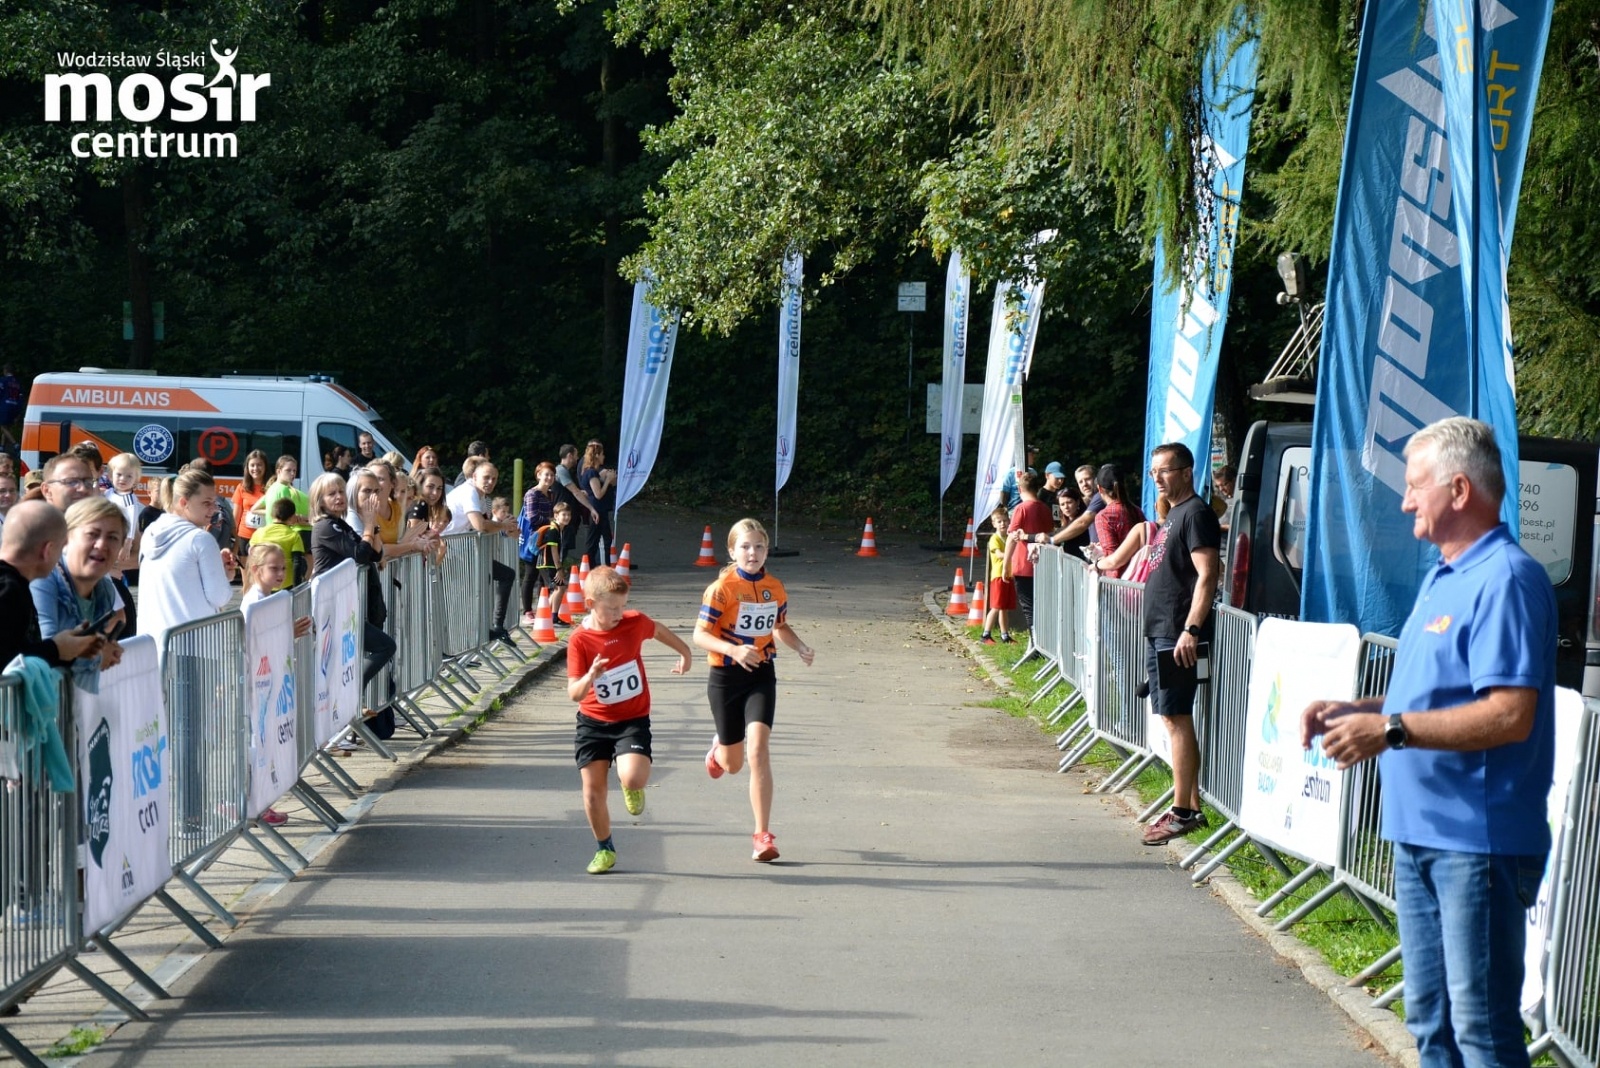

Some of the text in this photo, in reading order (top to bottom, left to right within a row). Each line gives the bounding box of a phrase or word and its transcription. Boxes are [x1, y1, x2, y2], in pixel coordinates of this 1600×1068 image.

[1487, 50, 1520, 151] ORT
[61, 388, 170, 406] AMBULANS
[209, 435, 228, 457] P
[218, 485, 235, 494] 514
[1518, 484, 1540, 495] 740
[1519, 517, 1555, 529] lbest.pl
[1518, 532, 1554, 543] best.pl
[739, 613, 775, 631] 366
[596, 674, 640, 699] 370
[1301, 771, 1331, 804] entrum
